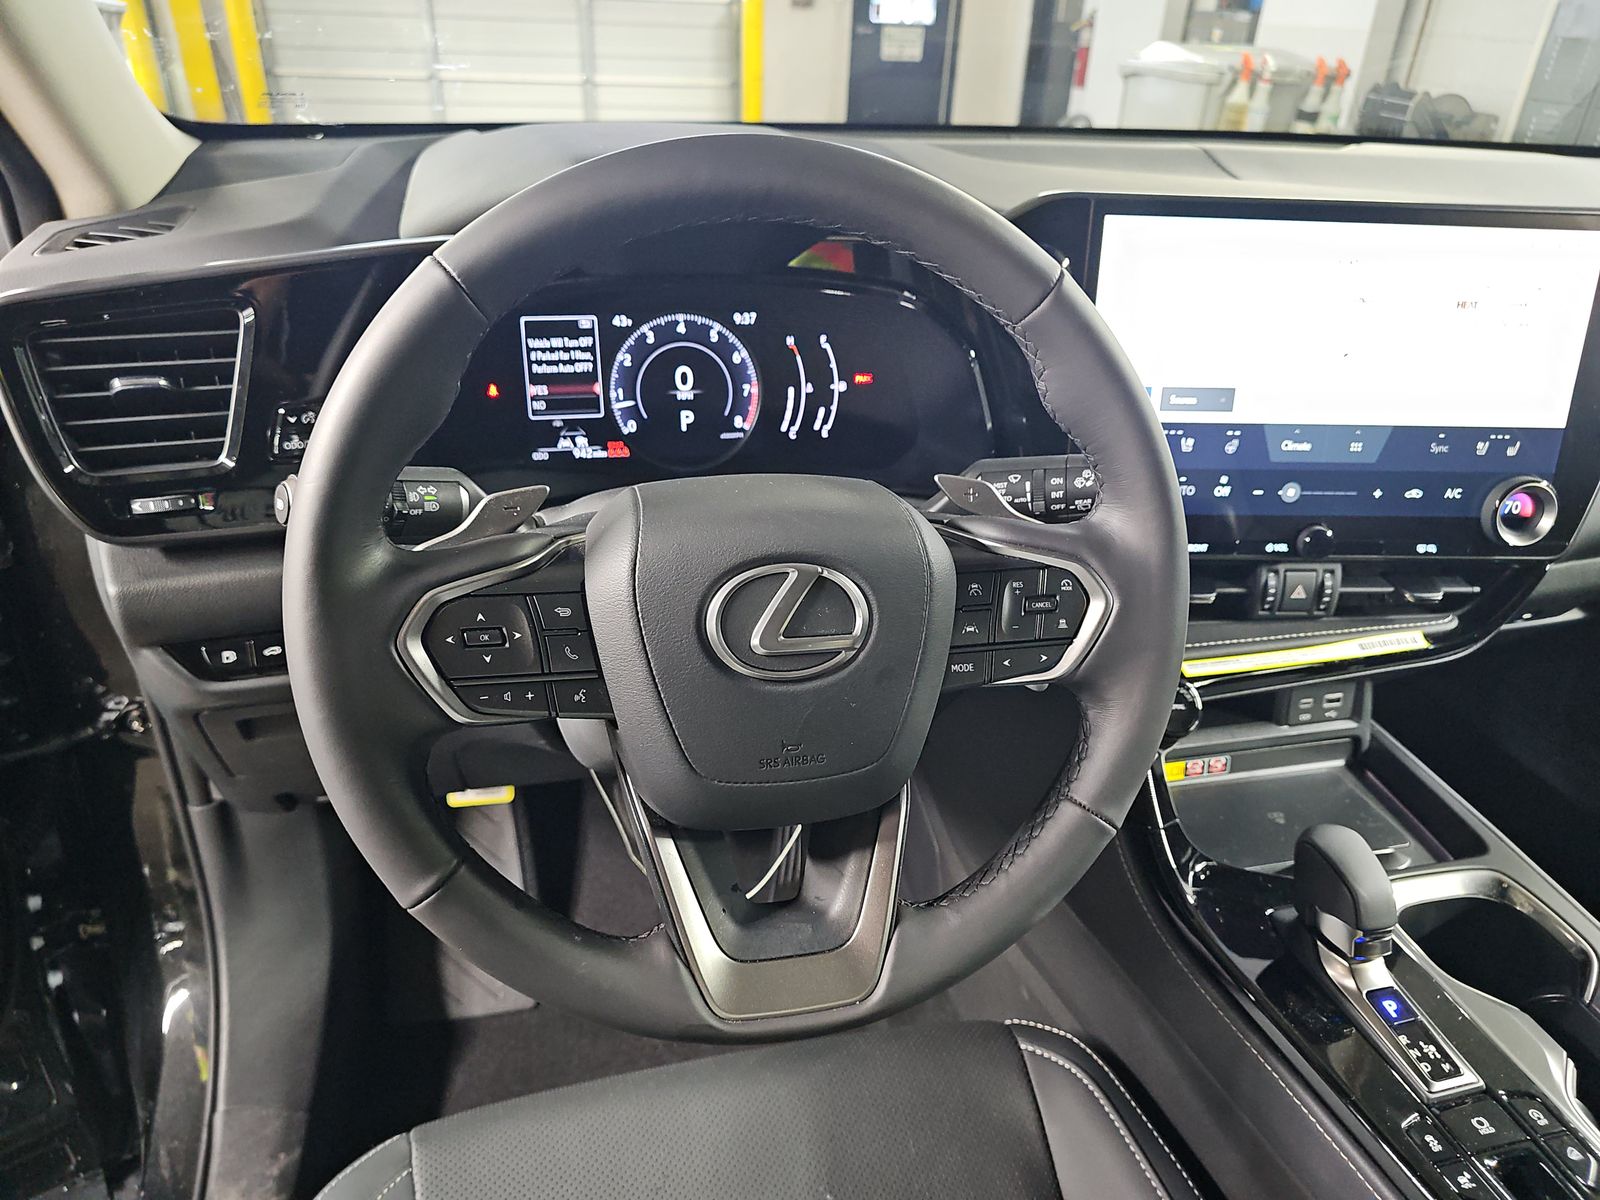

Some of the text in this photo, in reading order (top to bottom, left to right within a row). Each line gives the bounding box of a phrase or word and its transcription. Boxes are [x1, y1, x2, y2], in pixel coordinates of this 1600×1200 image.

[676, 321, 687, 335] 4
[578, 336, 594, 348] OFF
[645, 330, 655, 344] 3
[709, 328, 719, 343] 5
[622, 353, 632, 367] 2
[731, 350, 742, 364] 6
[674, 365, 695, 392] 0
[617, 387, 624, 400] 1
[742, 383, 751, 397] 7
[532, 400, 547, 411] NO
[626, 419, 638, 433] 0
[679, 410, 695, 432] P
[733, 415, 744, 429] 8
[1281, 440, 1313, 453] Climate
[1430, 442, 1449, 455] Sync
[1050, 477, 1064, 485] ON
[1050, 490, 1065, 499] INT
[1443, 488, 1463, 499] A/C
[1503, 500, 1521, 515] 70
[479, 634, 490, 642] OK
[951, 663, 975, 673] MODE
[758, 754, 827, 770] SRS AIRBAG
[1381, 998, 1399, 1018] P
[1398, 1034, 1411, 1045] R
[1409, 1047, 1422, 1059] N
[1419, 1062, 1432, 1073] D
